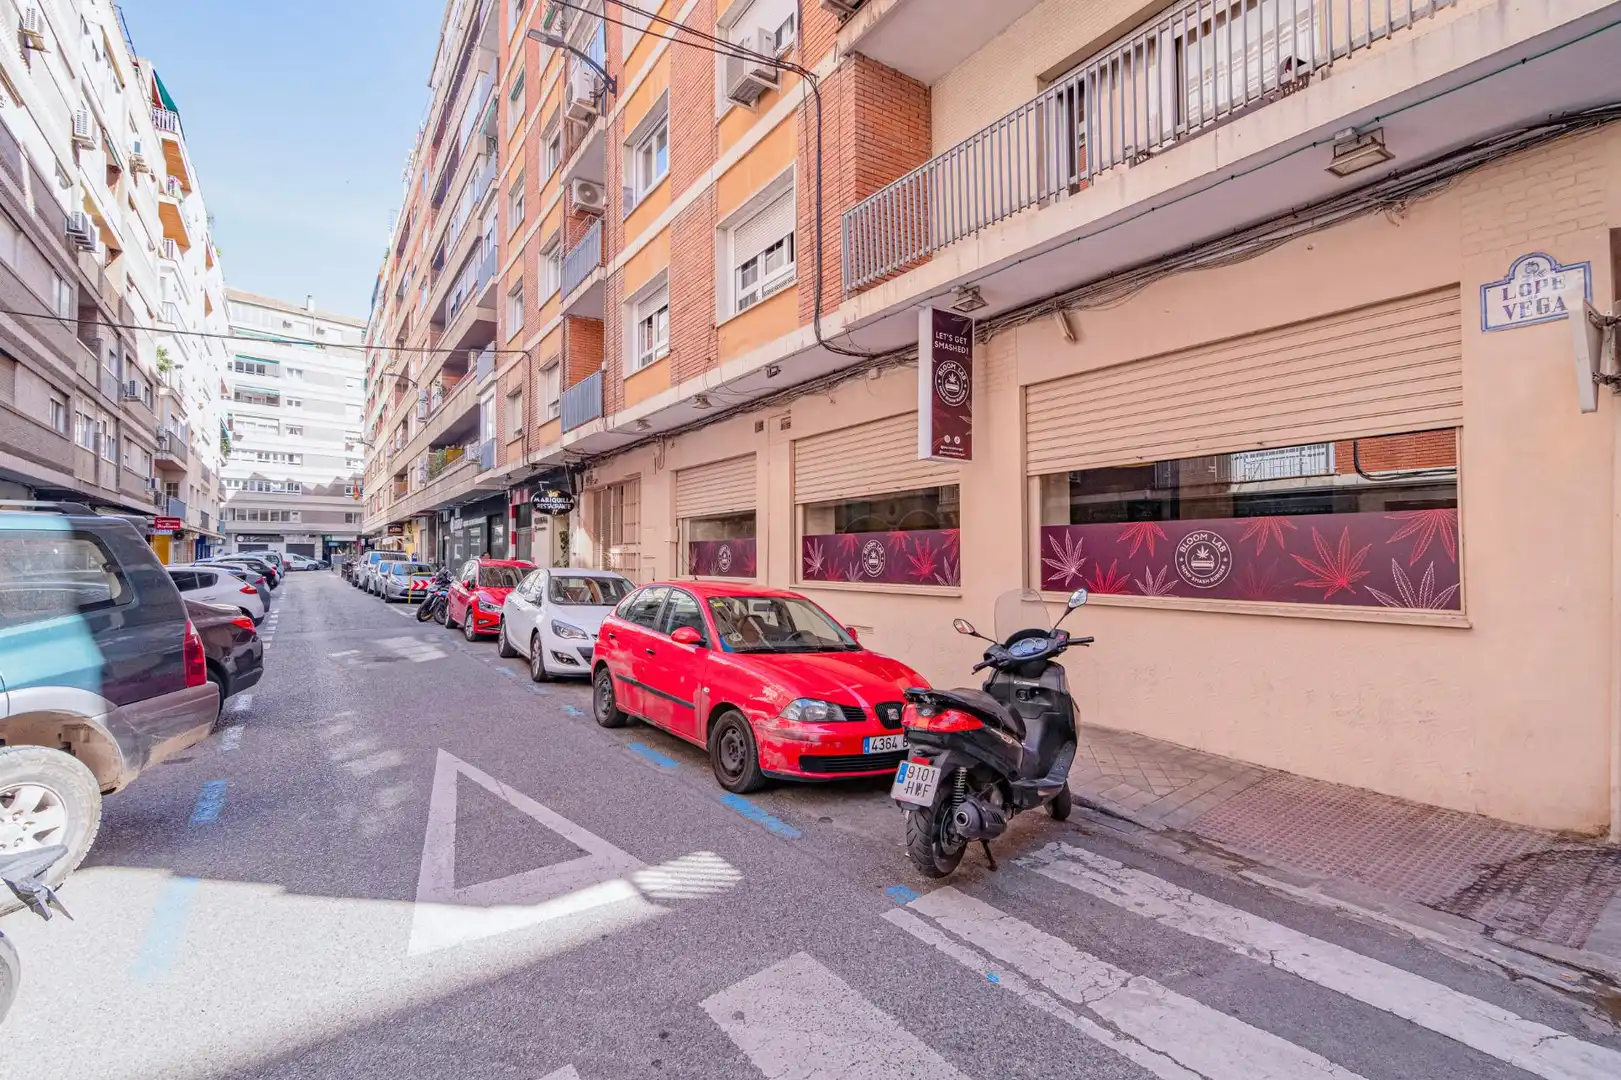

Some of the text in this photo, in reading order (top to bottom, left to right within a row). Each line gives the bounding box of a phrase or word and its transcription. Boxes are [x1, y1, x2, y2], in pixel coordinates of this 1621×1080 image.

[1502, 275, 1566, 301] LOPE
[1502, 296, 1568, 320] VEGA
[936, 331, 967, 345] LET'S GET
[934, 340, 969, 355] SMASHED!
[938, 363, 967, 381] BLOOM LAB
[1180, 533, 1227, 553] BLOOM LAB
[1191, 576, 1210, 584] SMASH
[871, 736, 898, 751] 4364
[907, 765, 936, 784] 9101
[905, 781, 932, 798] HWF
